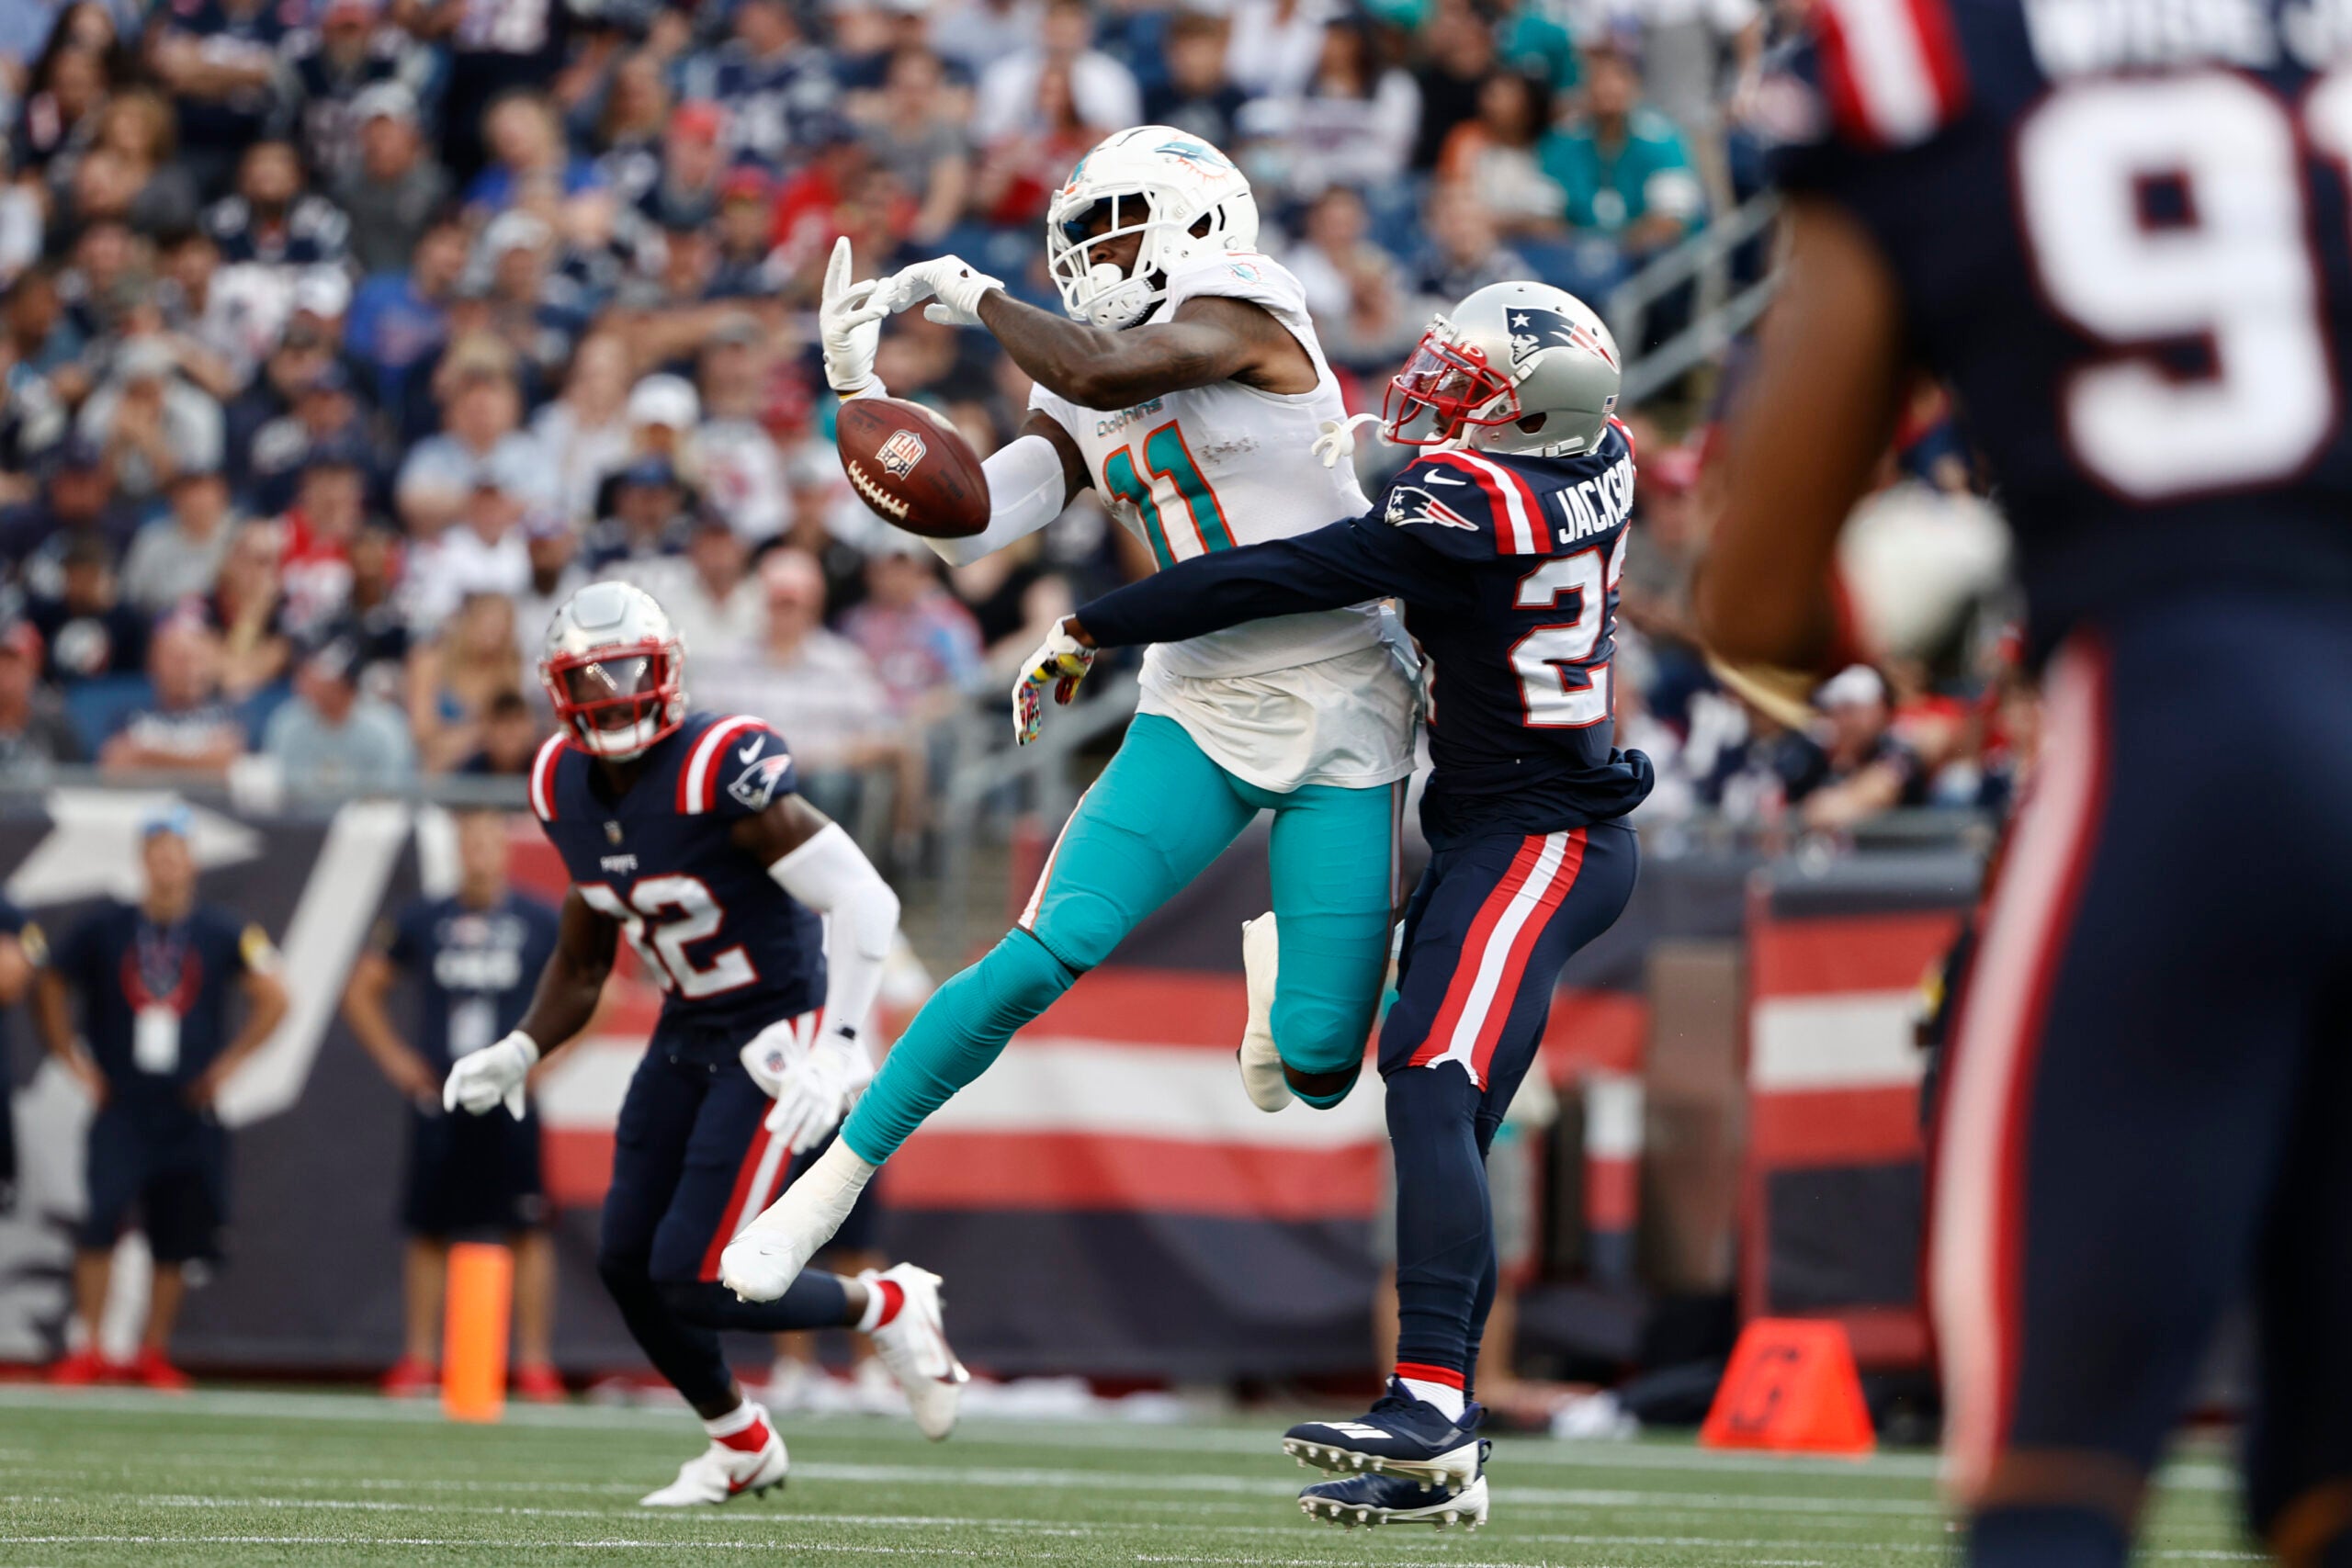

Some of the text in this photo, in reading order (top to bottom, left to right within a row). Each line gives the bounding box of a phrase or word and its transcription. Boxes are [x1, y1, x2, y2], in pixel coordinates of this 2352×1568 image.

[891, 434, 922, 464] NFL
[1096, 397, 1164, 439] Dolphins
[1102, 418, 1238, 573] 11
[1555, 450, 1635, 545] JACKSO
[575, 871, 762, 1001] 32
